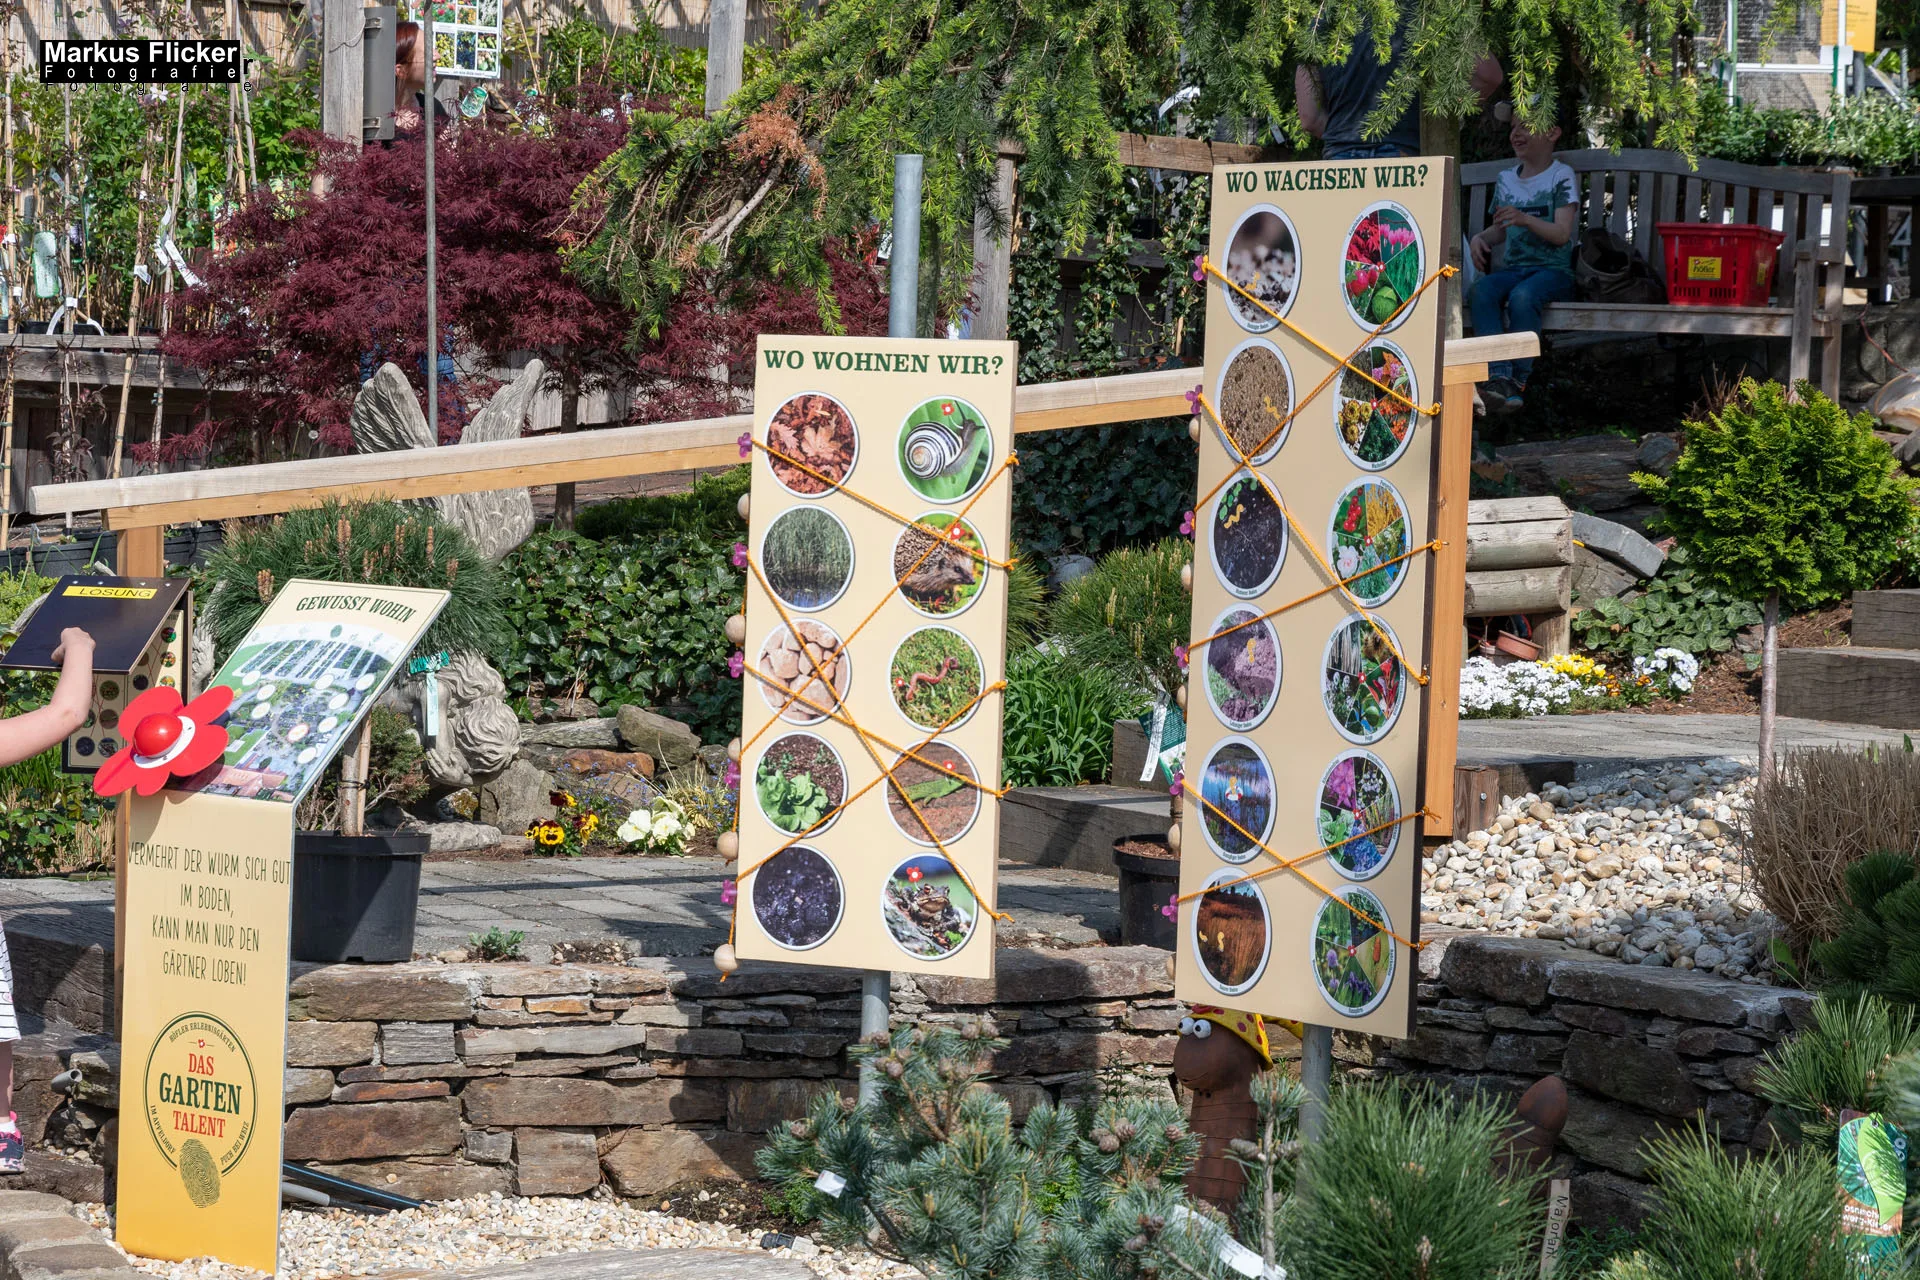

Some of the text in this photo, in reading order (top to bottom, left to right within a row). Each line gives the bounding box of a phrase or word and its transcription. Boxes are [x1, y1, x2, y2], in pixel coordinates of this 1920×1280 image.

[1225, 164, 1429, 193] WO WACHSEN WIR?
[763, 349, 1004, 375] WO WOHNEN WIR?
[296, 595, 417, 623] GEWUSST WOHIN
[128, 841, 291, 885] VERMEHRT DER WURM SICH GUT
[180, 883, 234, 918] IM BODEN,
[152, 914, 260, 953] KANN MAN NUR DEN
[163, 949, 247, 987] GÄRTNER LOBEN!
[188, 1053, 215, 1076] DAS
[159, 1072, 242, 1115] GARTEN
[172, 1110, 226, 1138] TALENT
